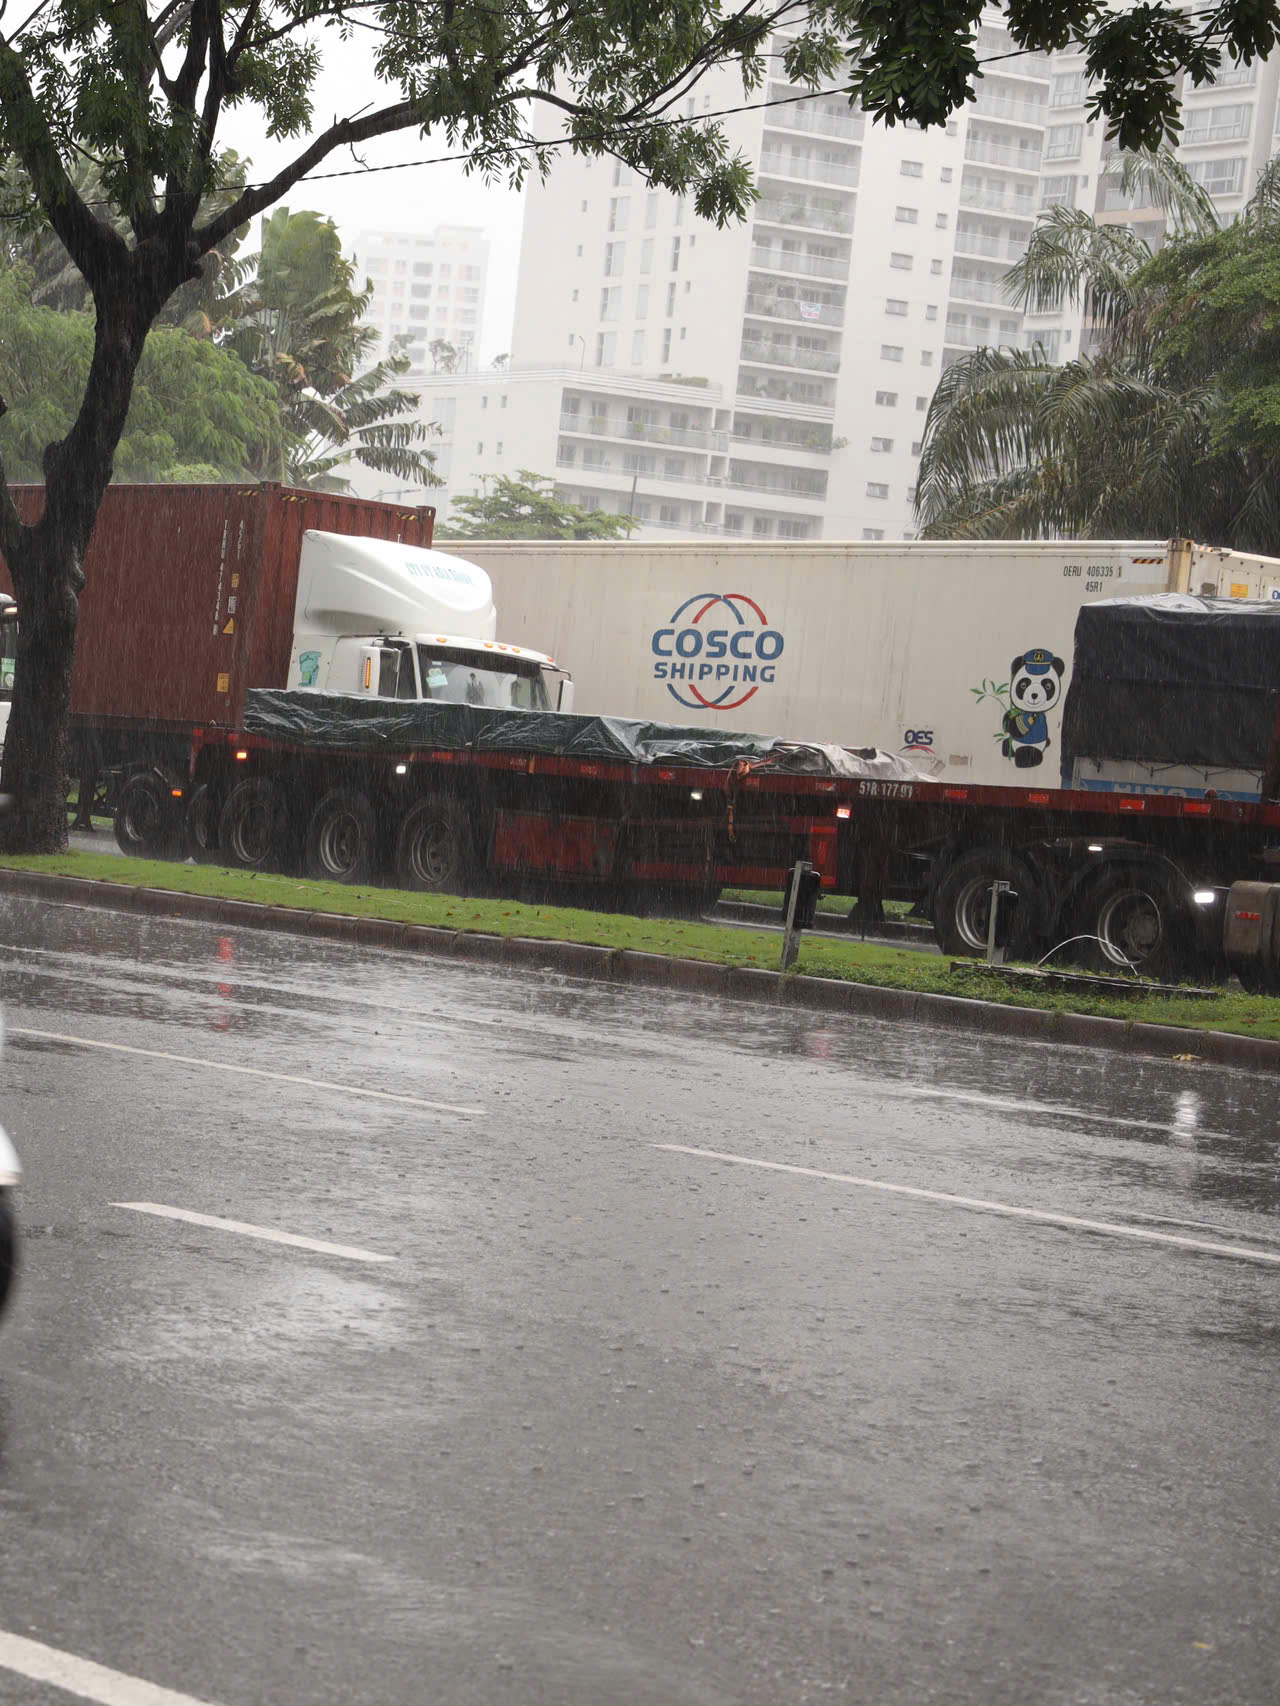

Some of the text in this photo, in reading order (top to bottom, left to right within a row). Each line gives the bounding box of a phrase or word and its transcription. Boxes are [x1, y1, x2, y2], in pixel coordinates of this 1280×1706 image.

[1063, 566, 1082, 576] OERU
[1087, 566, 1113, 577] 406335
[1085, 581, 1103, 592] 45R1
[652, 628, 784, 660] COSCO
[654, 662, 776, 683] SHIPPING
[904, 730, 934, 746] OES
